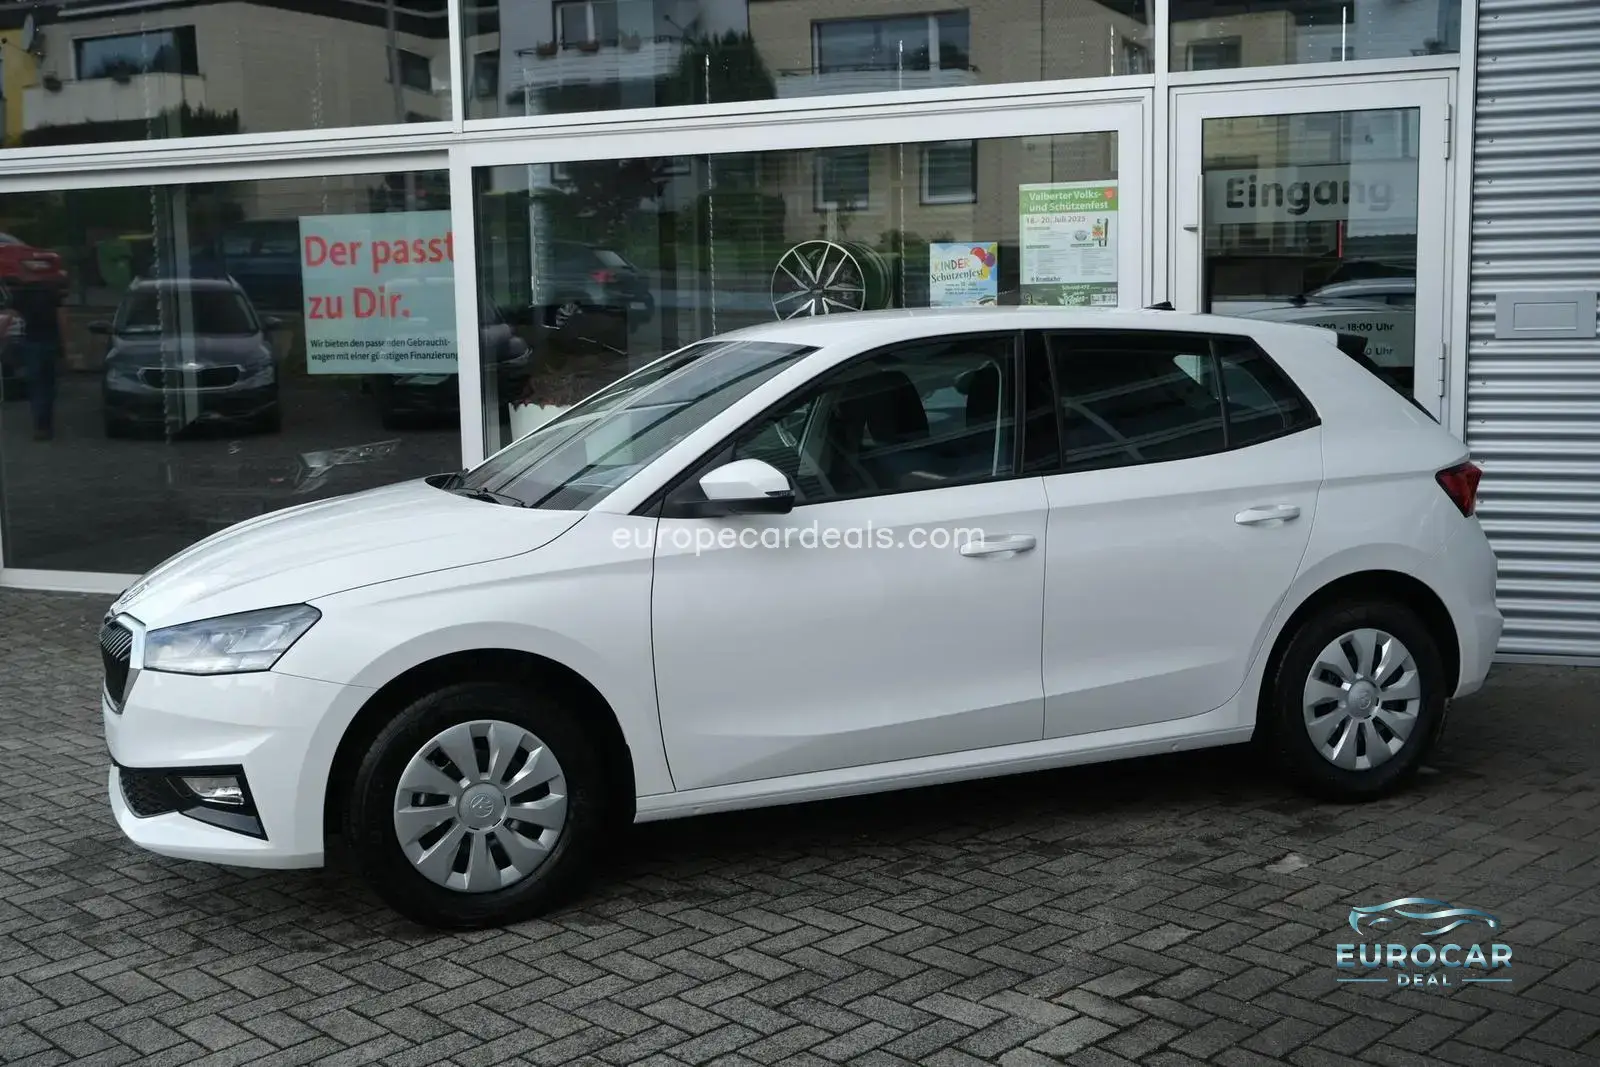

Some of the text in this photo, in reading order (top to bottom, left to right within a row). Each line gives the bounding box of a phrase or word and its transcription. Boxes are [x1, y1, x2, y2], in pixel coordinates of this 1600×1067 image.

[1073, 189, 1102, 199] Volks-
[1226, 174, 1394, 215] Eingang
[1029, 201, 1108, 212] und Schützenfest
[304, 231, 455, 274] Der passt
[934, 258, 970, 272] KINDER
[308, 286, 411, 319] zu Dir.
[1347, 323, 1373, 331] 18:00
[1375, 323, 1395, 331] Uhr
[310, 339, 325, 348] Wir
[325, 338, 349, 348] bieten
[350, 338, 364, 347] den
[406, 337, 451, 347] Gebraucht-
[311, 353, 337, 362] wagen
[337, 351, 349, 360] mit
[350, 351, 370, 360] einer
[1375, 347, 1394, 355] Uhr
